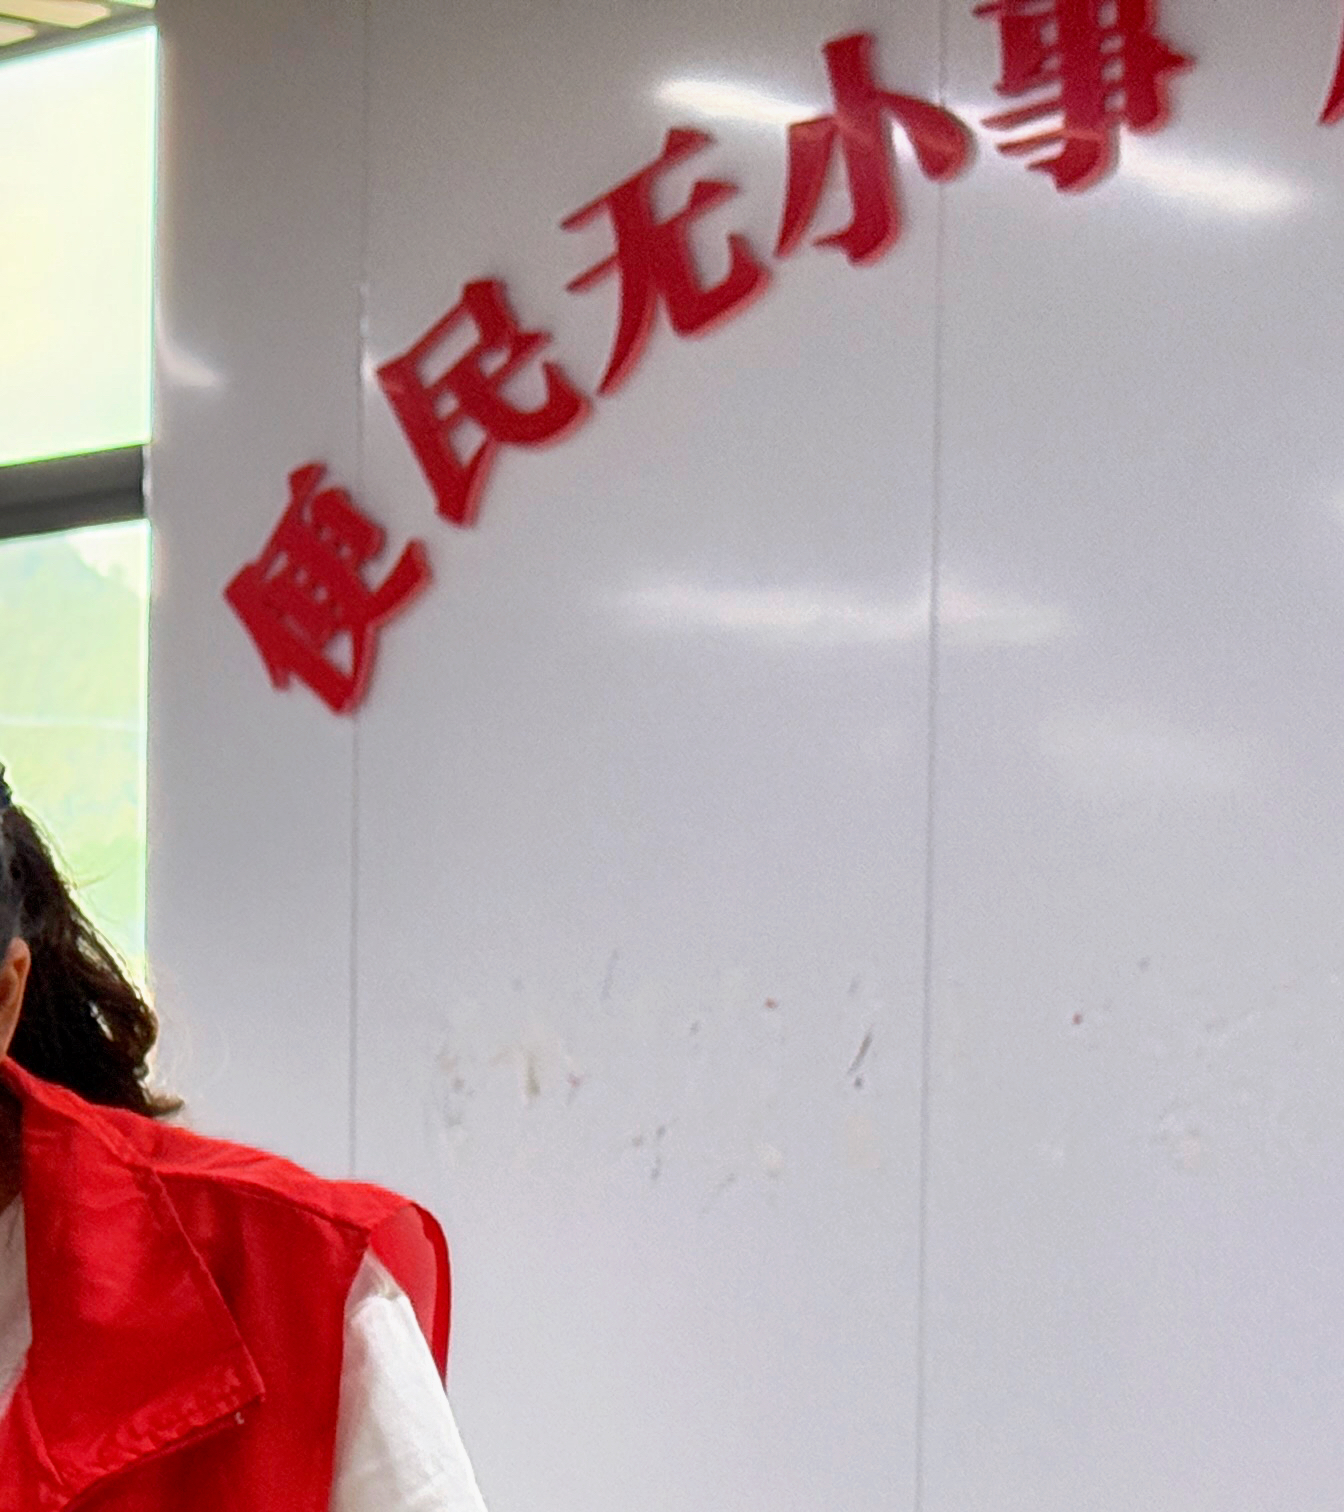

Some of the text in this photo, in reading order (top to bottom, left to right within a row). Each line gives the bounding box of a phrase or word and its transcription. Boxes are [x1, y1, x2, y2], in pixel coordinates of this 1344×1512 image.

[223, 0, 1194, 716] 便民无小事
